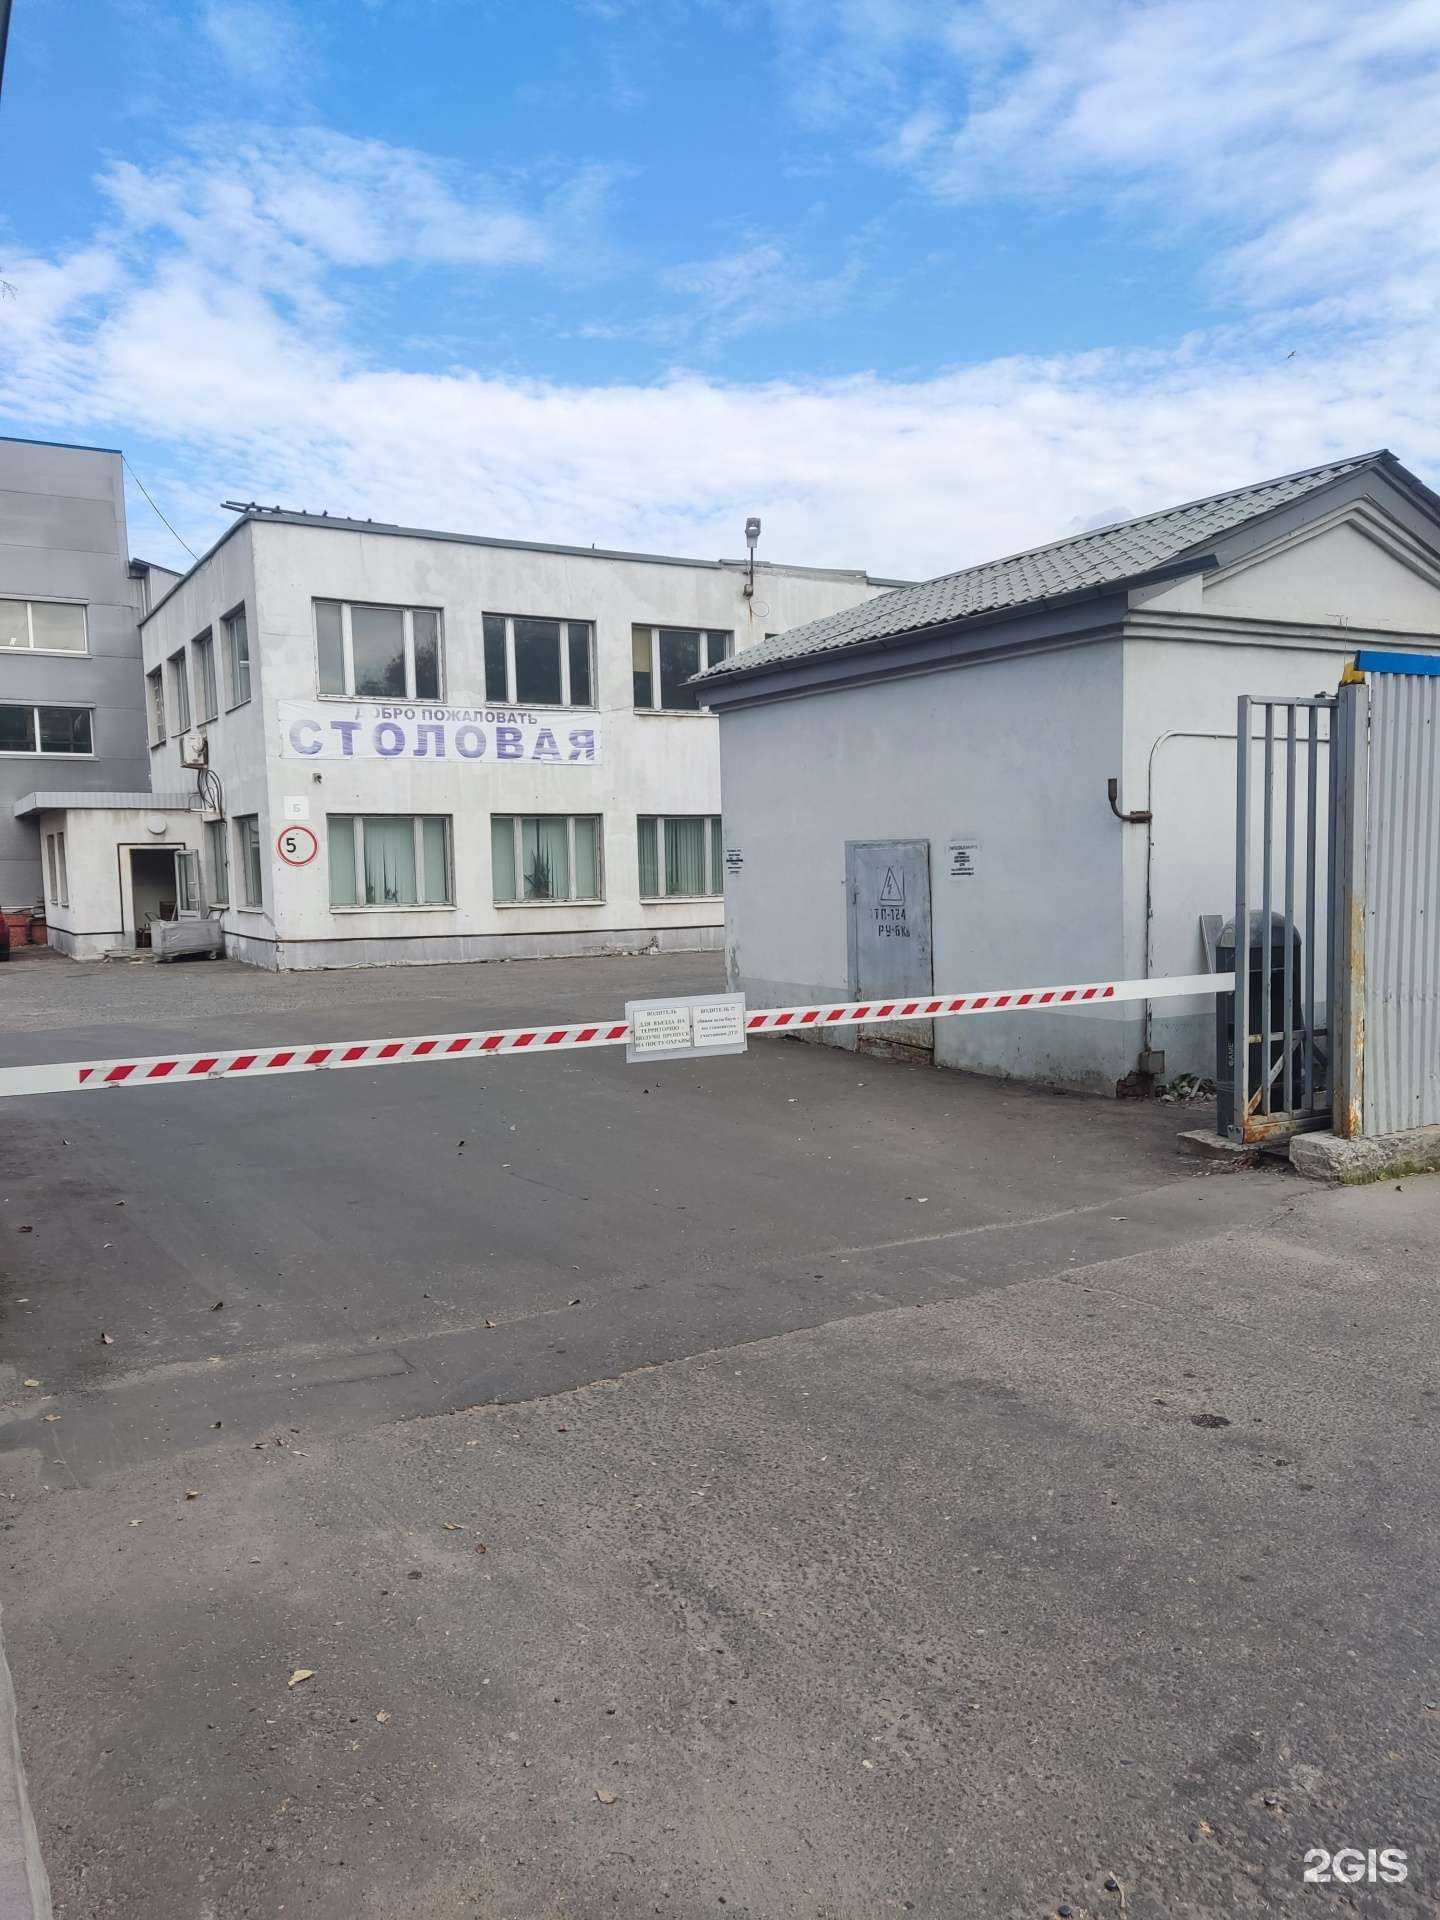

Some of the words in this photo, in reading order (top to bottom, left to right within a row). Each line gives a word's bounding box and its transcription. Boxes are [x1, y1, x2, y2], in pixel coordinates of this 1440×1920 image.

[355, 707, 416, 721] БРО
[421, 709, 538, 725] ПОЖАЛОВАТЬ
[289, 718, 596, 761] СТОЛОВАЯ
[286, 837, 297, 854] 5
